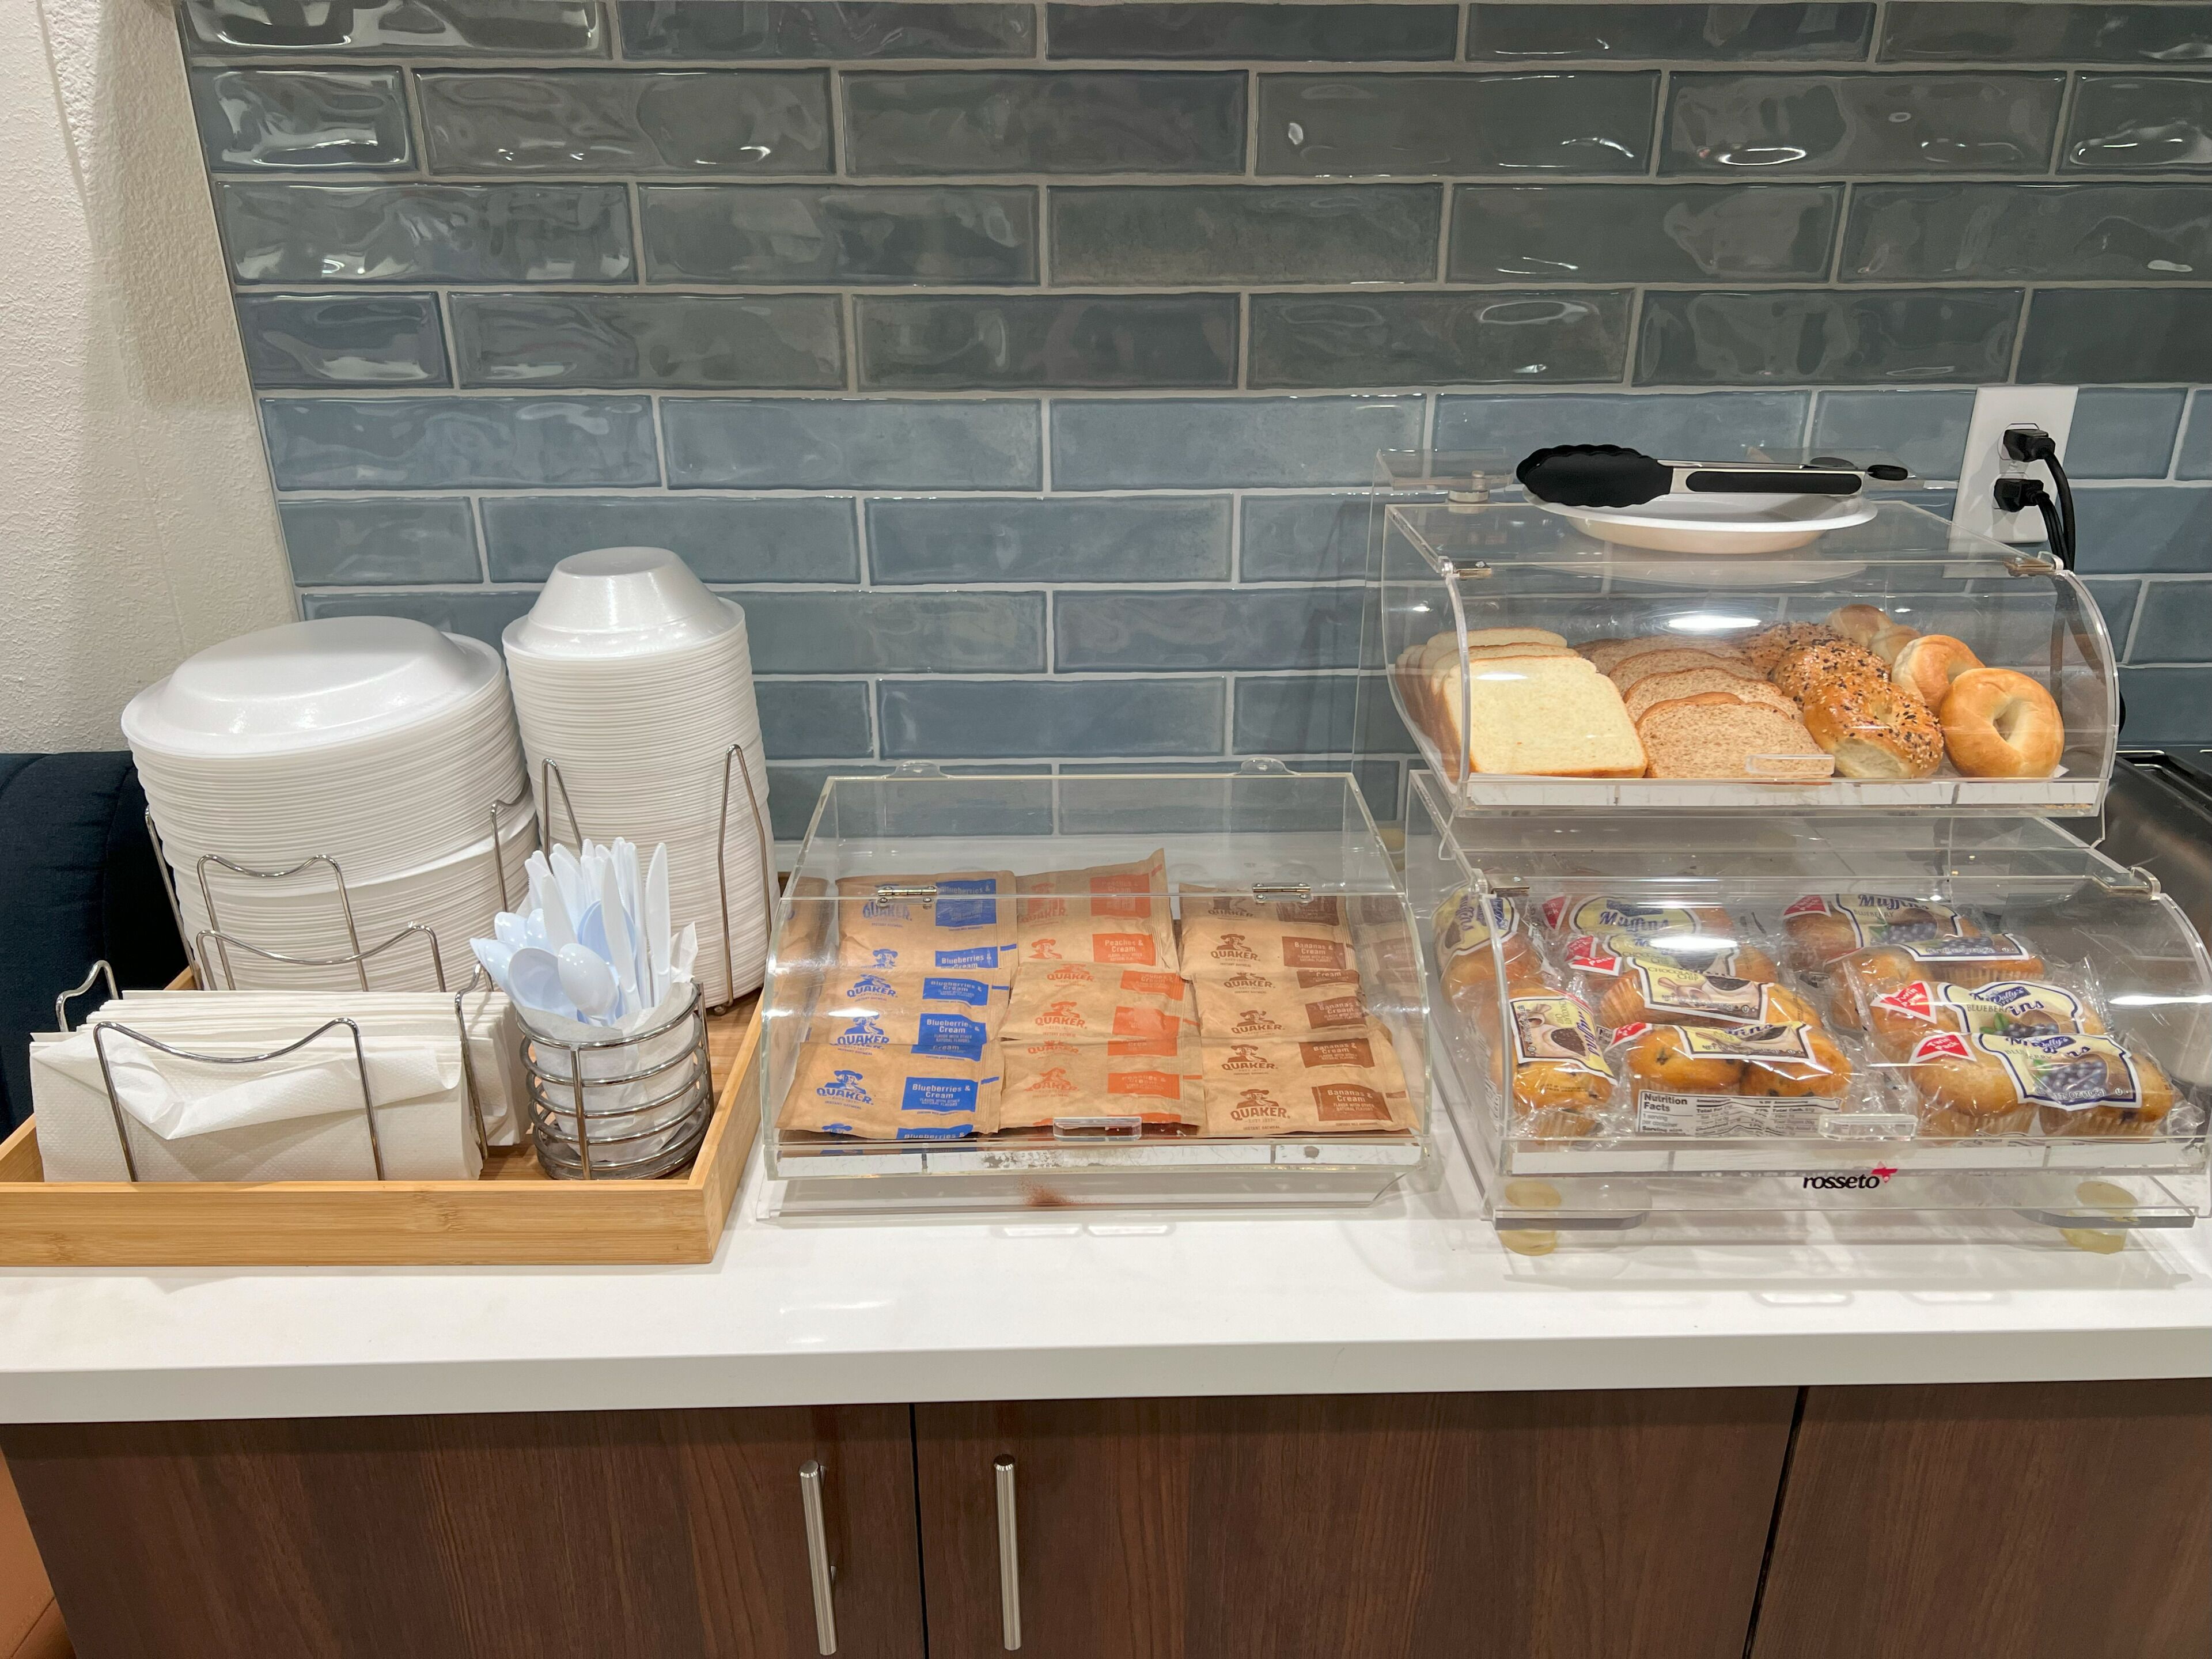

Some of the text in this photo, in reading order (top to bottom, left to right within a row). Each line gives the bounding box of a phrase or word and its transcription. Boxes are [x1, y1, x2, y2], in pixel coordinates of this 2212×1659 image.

[1294, 941, 1326, 950] Bananas
[941, 956, 984, 964] Blueberries
[1211, 950, 1258, 961] QUAKER
[1047, 973, 1094, 982] QUAKER
[931, 980, 975, 989] Blueberries
[847, 986, 896, 998] QUAKER
[1893, 988, 1918, 1002] Twin
[1558, 1001, 1573, 1025] CHOCOLATE
[1966, 1004, 2010, 1013] BLUEBER
[926, 1018, 972, 1028] Blueberrie
[1035, 1016, 1086, 1028] QUAKER
[939, 1026, 966, 1034] Cream
[1230, 1024, 1282, 1034] QUAKER
[837, 1035, 890, 1045] QUAKER
[1926, 1037, 1952, 1048] Twin
[1313, 1043, 1349, 1052] Bananas
[1934, 1041, 1960, 1051] Pack
[1221, 1062, 1275, 1070] QUAKER
[912, 1084, 962, 1093] Blueberries
[2081, 1088, 2107, 1099] (106g)
[816, 1087, 872, 1104] QUAKER
[925, 1091, 954, 1099] Cream
[1643, 1093, 1688, 1105] Nutrition
[1643, 1101, 1671, 1112] Facts
[1230, 1107, 1287, 1121] QUAKER
[1802, 1173, 1880, 1190] rosseto
